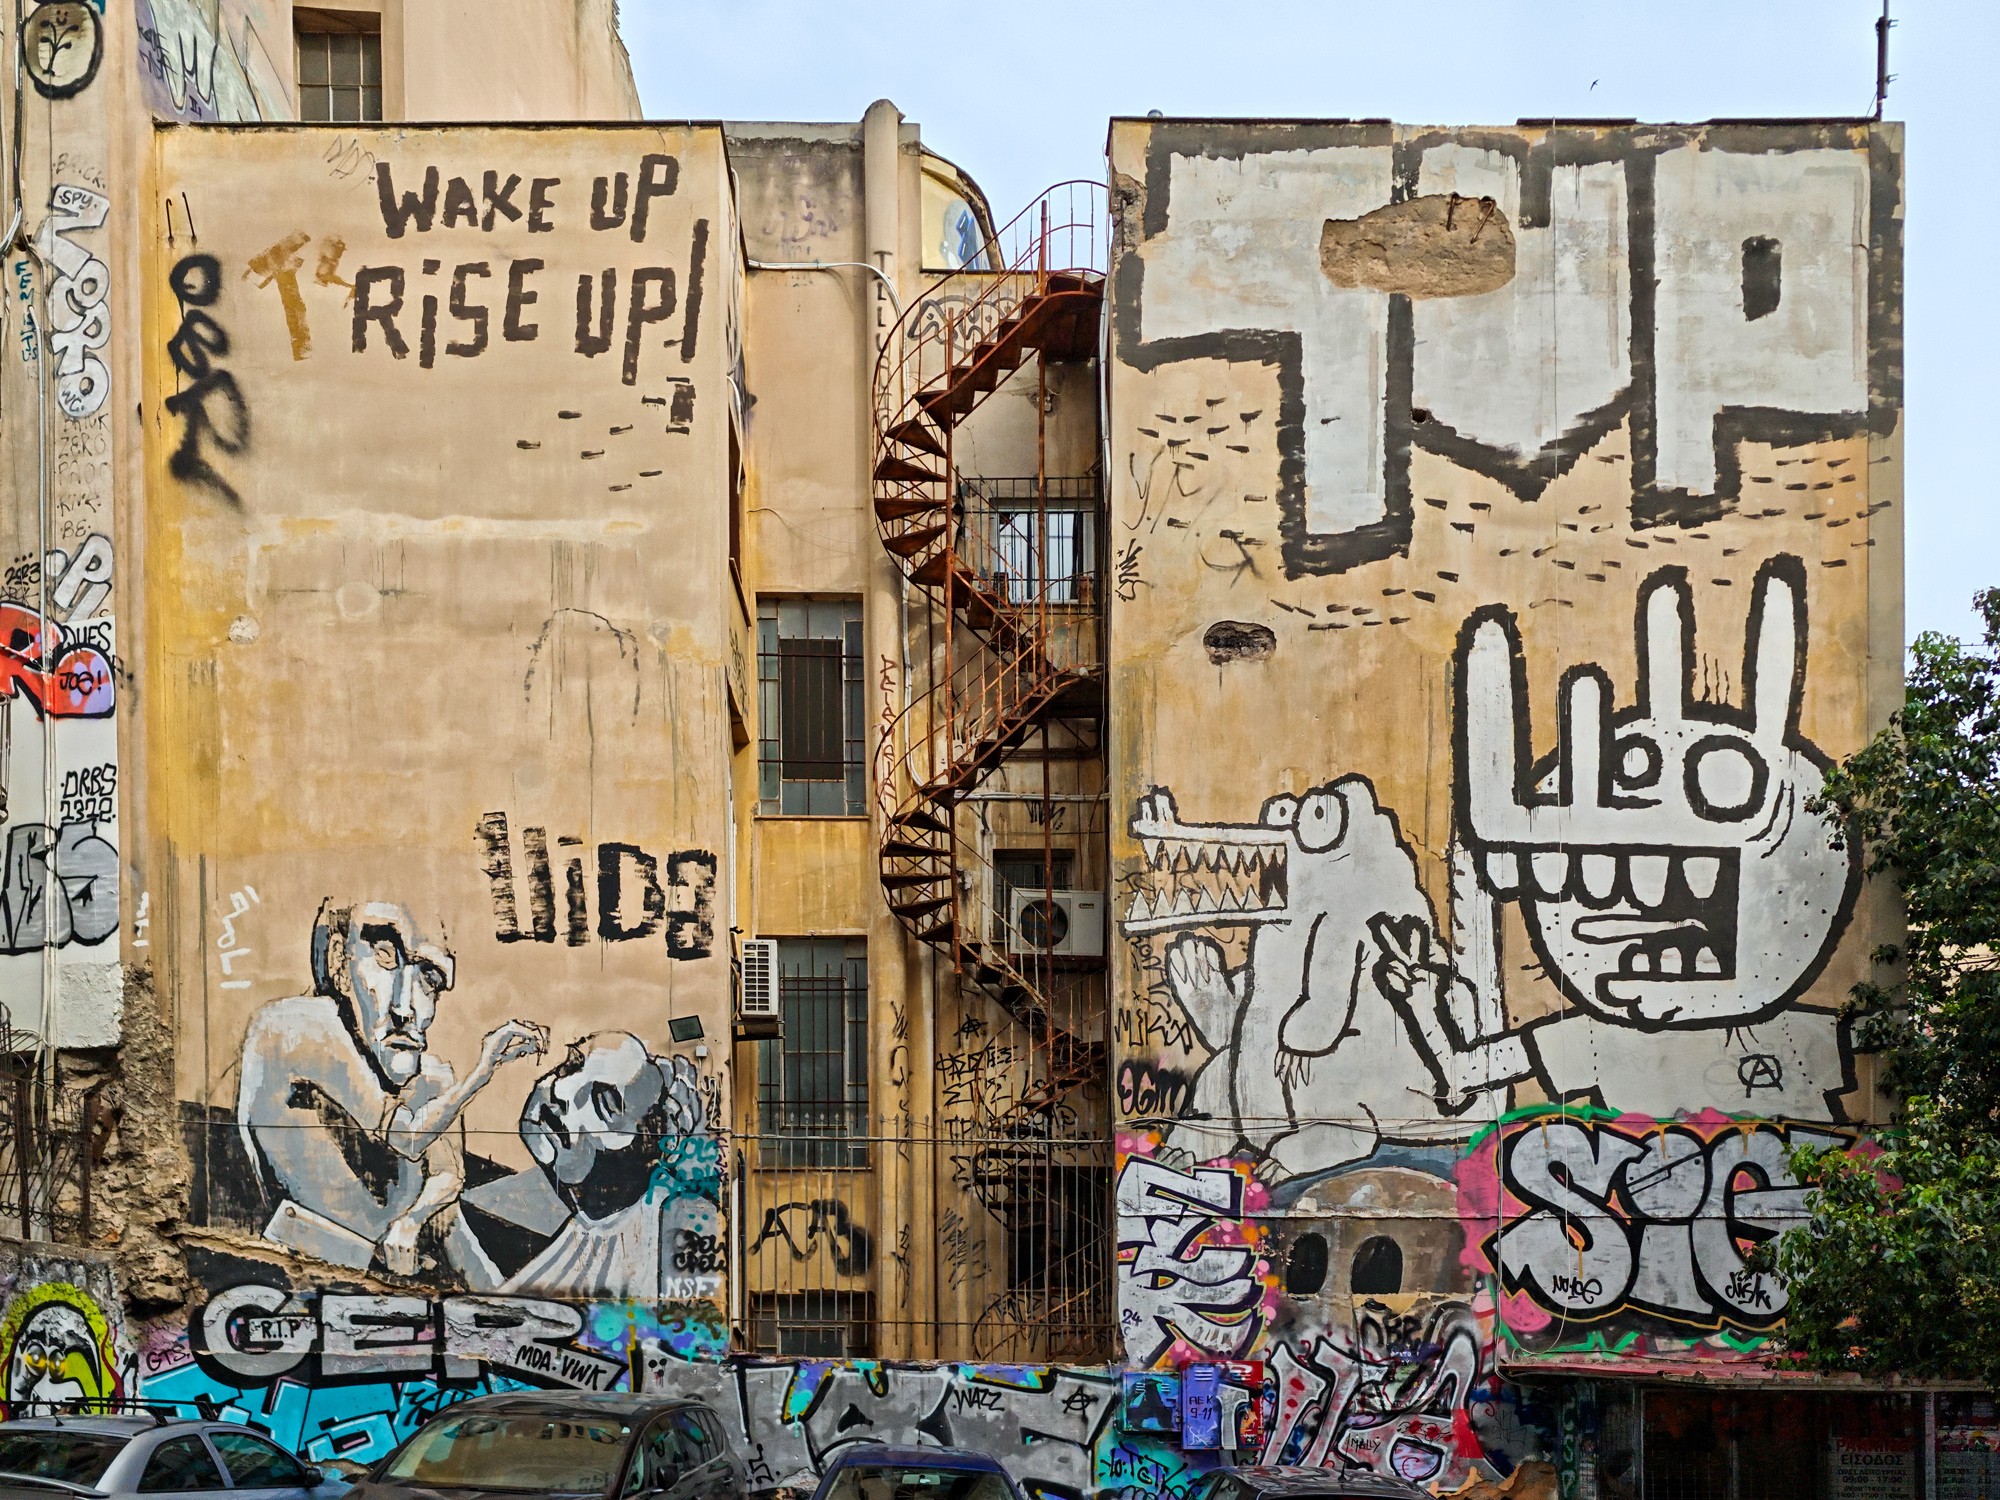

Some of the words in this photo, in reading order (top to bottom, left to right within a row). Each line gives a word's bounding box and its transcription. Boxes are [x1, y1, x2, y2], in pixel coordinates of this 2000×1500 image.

[375, 162, 561, 239] WAKE
[590, 154, 680, 243] UP
[1841, 1454, 1904, 1466] ΕΙΣΟΔΟΣ
